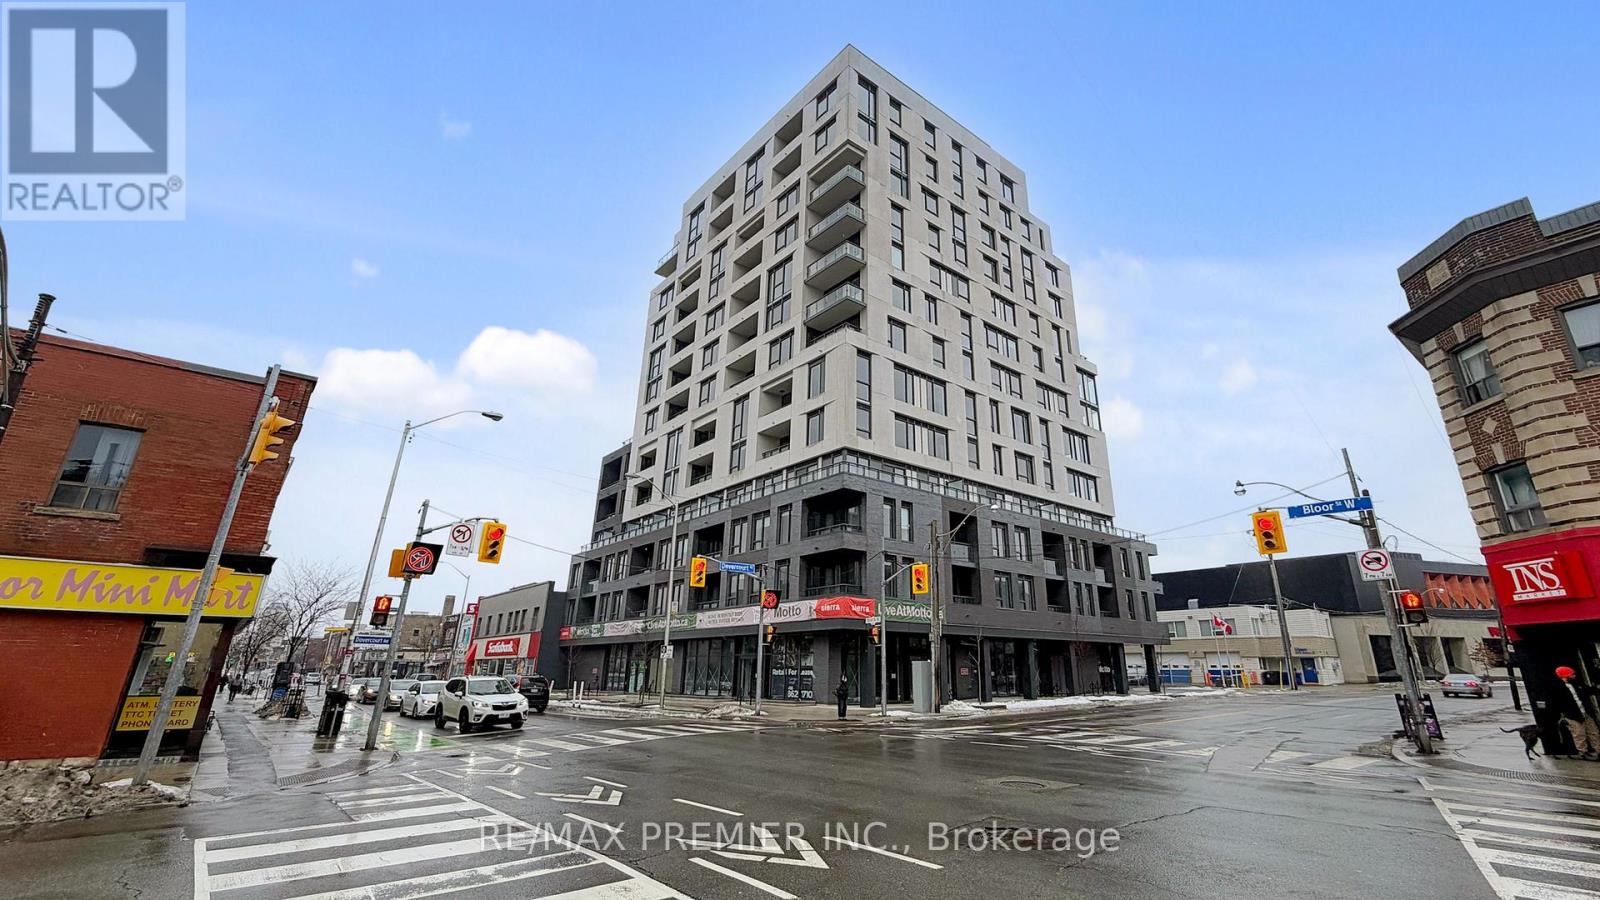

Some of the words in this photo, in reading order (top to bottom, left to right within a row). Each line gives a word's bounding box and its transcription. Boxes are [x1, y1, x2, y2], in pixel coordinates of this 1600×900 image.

[1302, 503, 1334, 515] Bloor
[1344, 499, 1355, 509] W
[1505, 561, 1561, 594] INS
[0, 576, 44, 600] or
[56, 568, 160, 605] Mini
[773, 605, 802, 618] Motto
[821, 603, 840, 612] sierra
[851, 603, 870, 613] sierra
[878, 603, 944, 619] LveAtMottoa
[154, 700, 199, 710] LTERY
[147, 709, 185, 718] TIET
